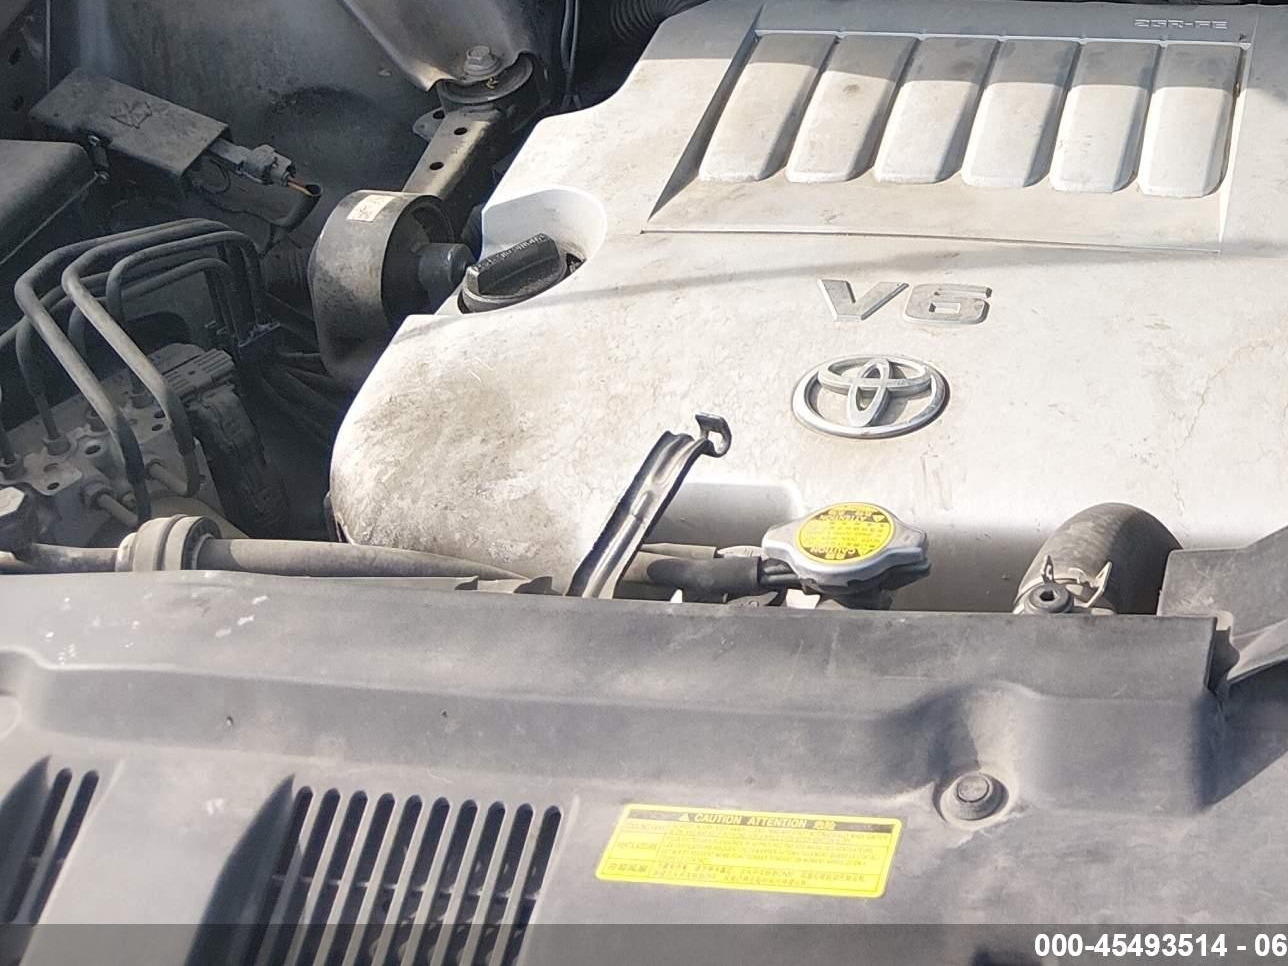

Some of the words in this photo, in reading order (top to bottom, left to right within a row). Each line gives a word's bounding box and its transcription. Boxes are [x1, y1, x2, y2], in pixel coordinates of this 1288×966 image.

[817, 279, 993, 325] V6
[694, 813, 742, 825] CAUTION
[746, 816, 808, 828] ATTENTION
